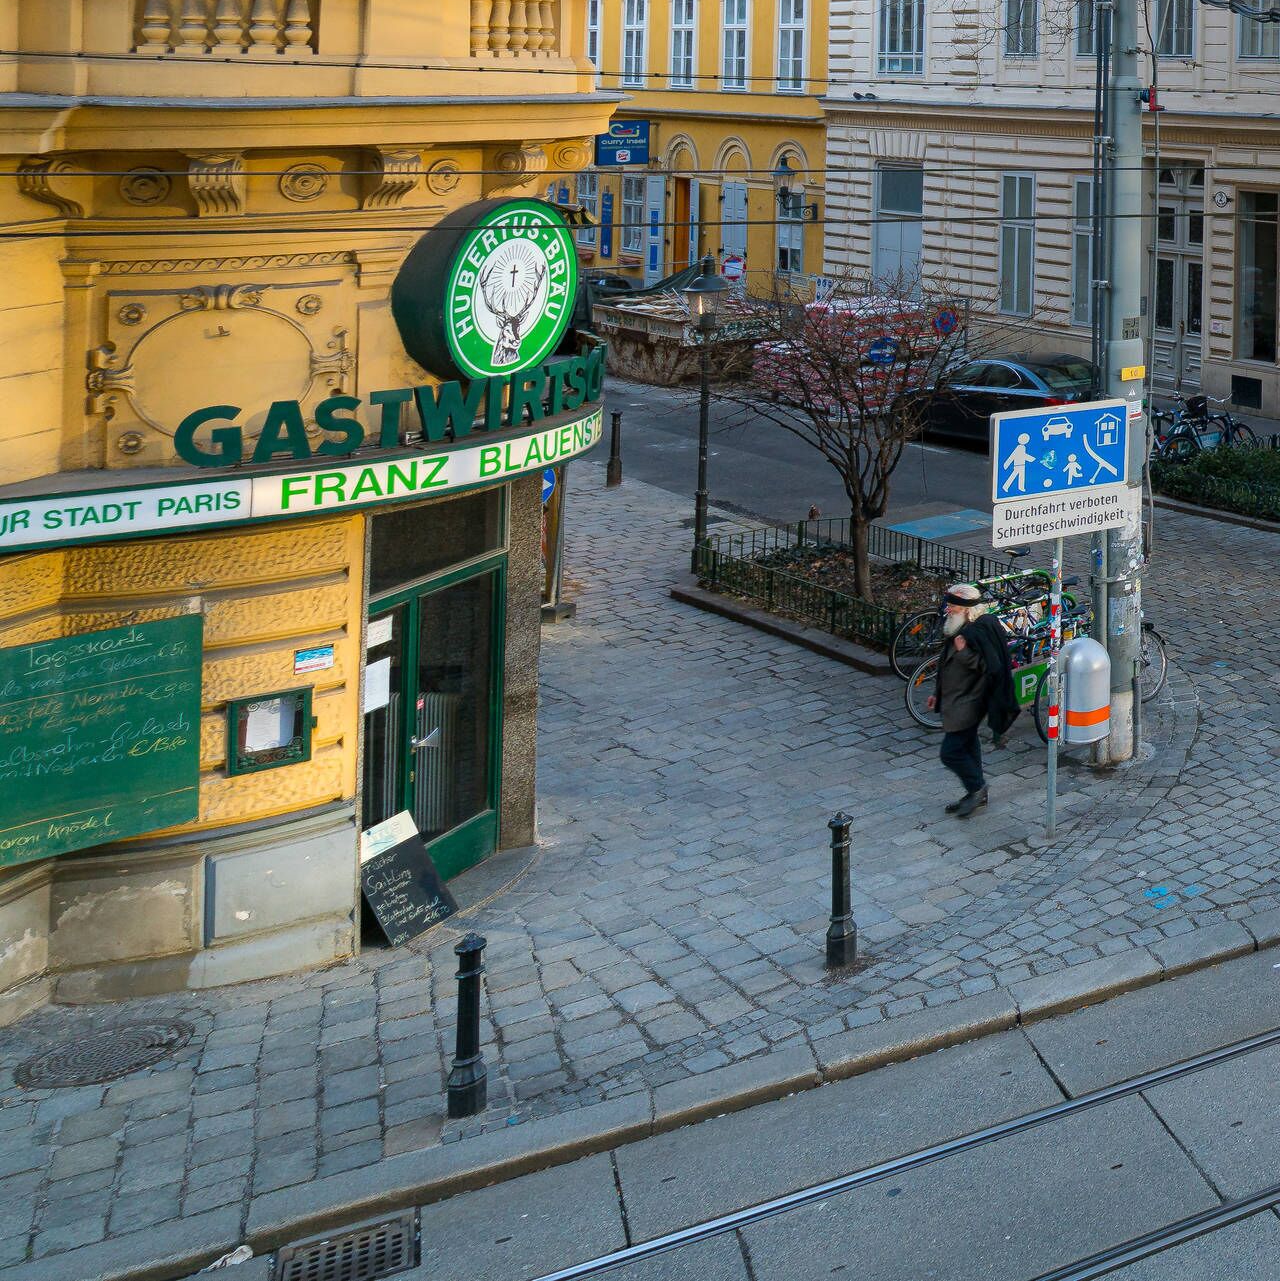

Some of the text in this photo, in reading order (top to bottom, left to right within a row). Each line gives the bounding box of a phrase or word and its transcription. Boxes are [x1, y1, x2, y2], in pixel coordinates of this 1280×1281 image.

[454, 216, 567, 339] HUBERTUS-BRÄU
[280, 456, 449, 510] FRANZ
[42, 500, 142, 530] STADT
[157, 490, 241, 518] PARIS
[997, 509, 1125, 540] Schrittgeschwindigkeit
[1005, 495, 1118, 521] Durchfahrt verboten
